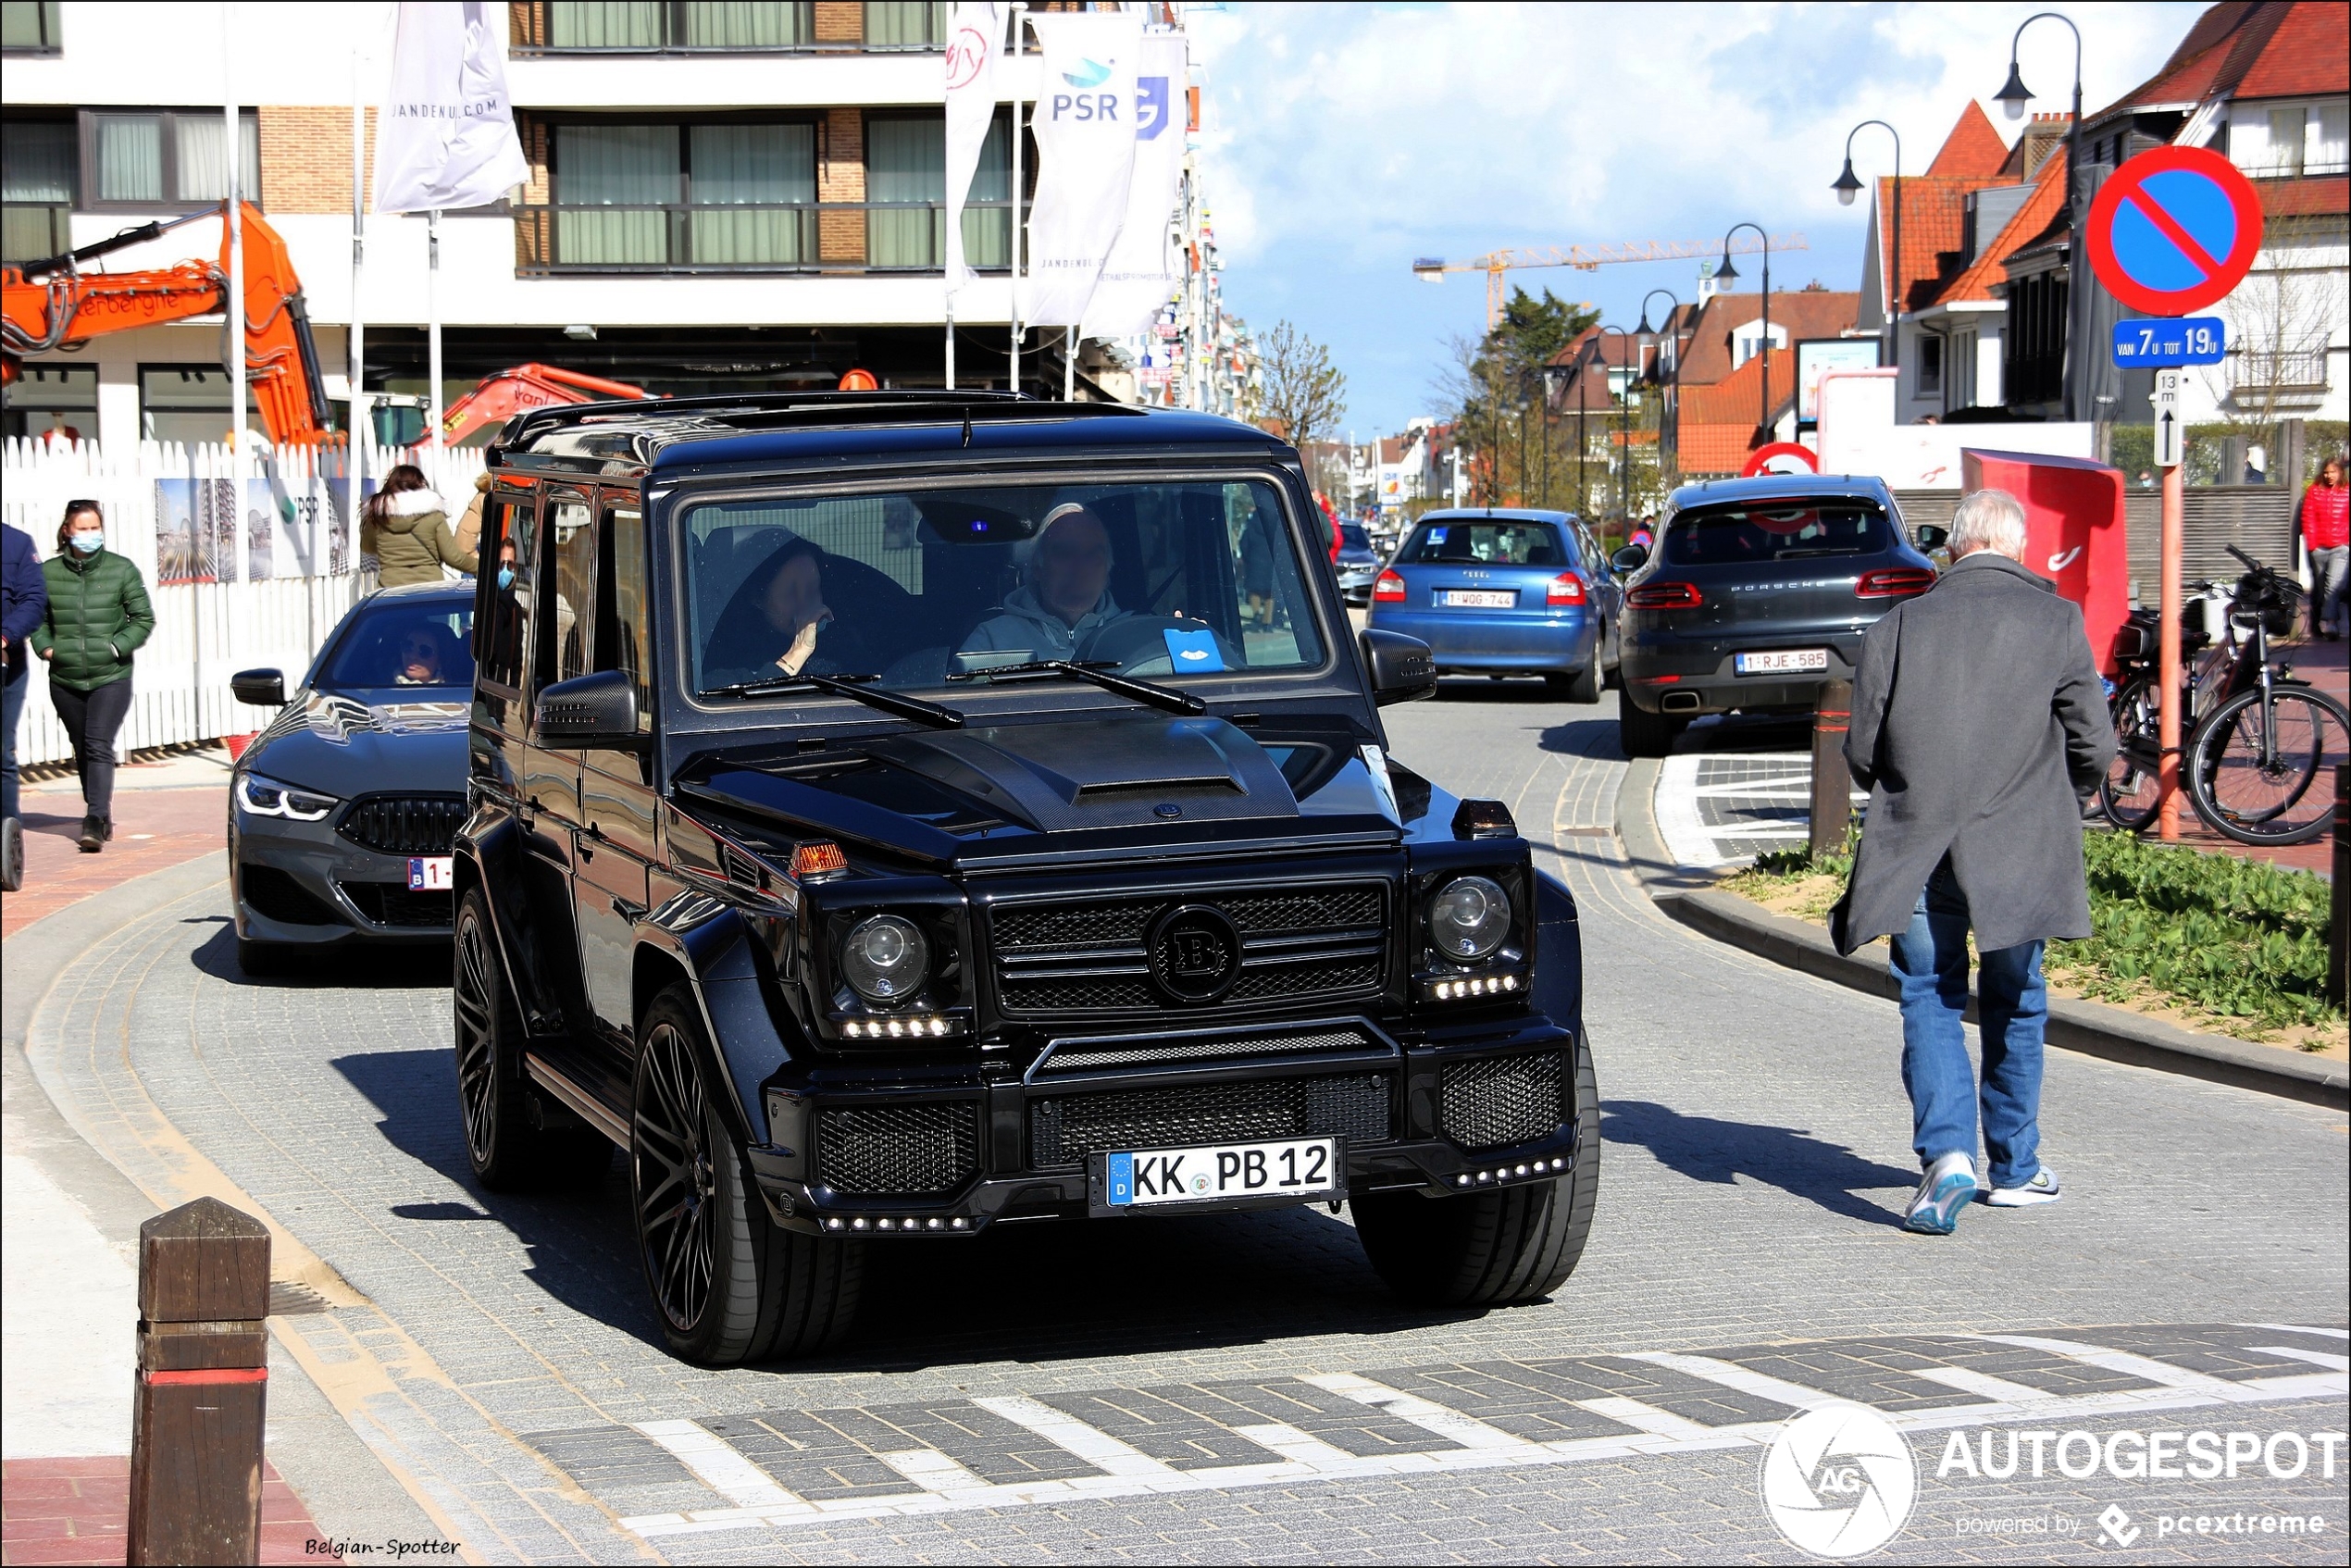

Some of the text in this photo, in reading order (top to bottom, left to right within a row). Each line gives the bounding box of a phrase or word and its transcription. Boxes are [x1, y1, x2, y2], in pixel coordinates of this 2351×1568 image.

[1051, 93, 1118, 121] PSR
[2117, 343, 2133, 356] VAN
[2163, 342, 2181, 355] TOT
[2161, 376, 2176, 389] 13
[2161, 392, 2174, 402] m
[297, 496, 320, 525] PSR
[1430, 529, 1443, 540] L
[1731, 581, 1825, 591] PORSCHE
[413, 874, 422, 885] B
[1116, 1145, 1327, 1197] D KK PB 12
